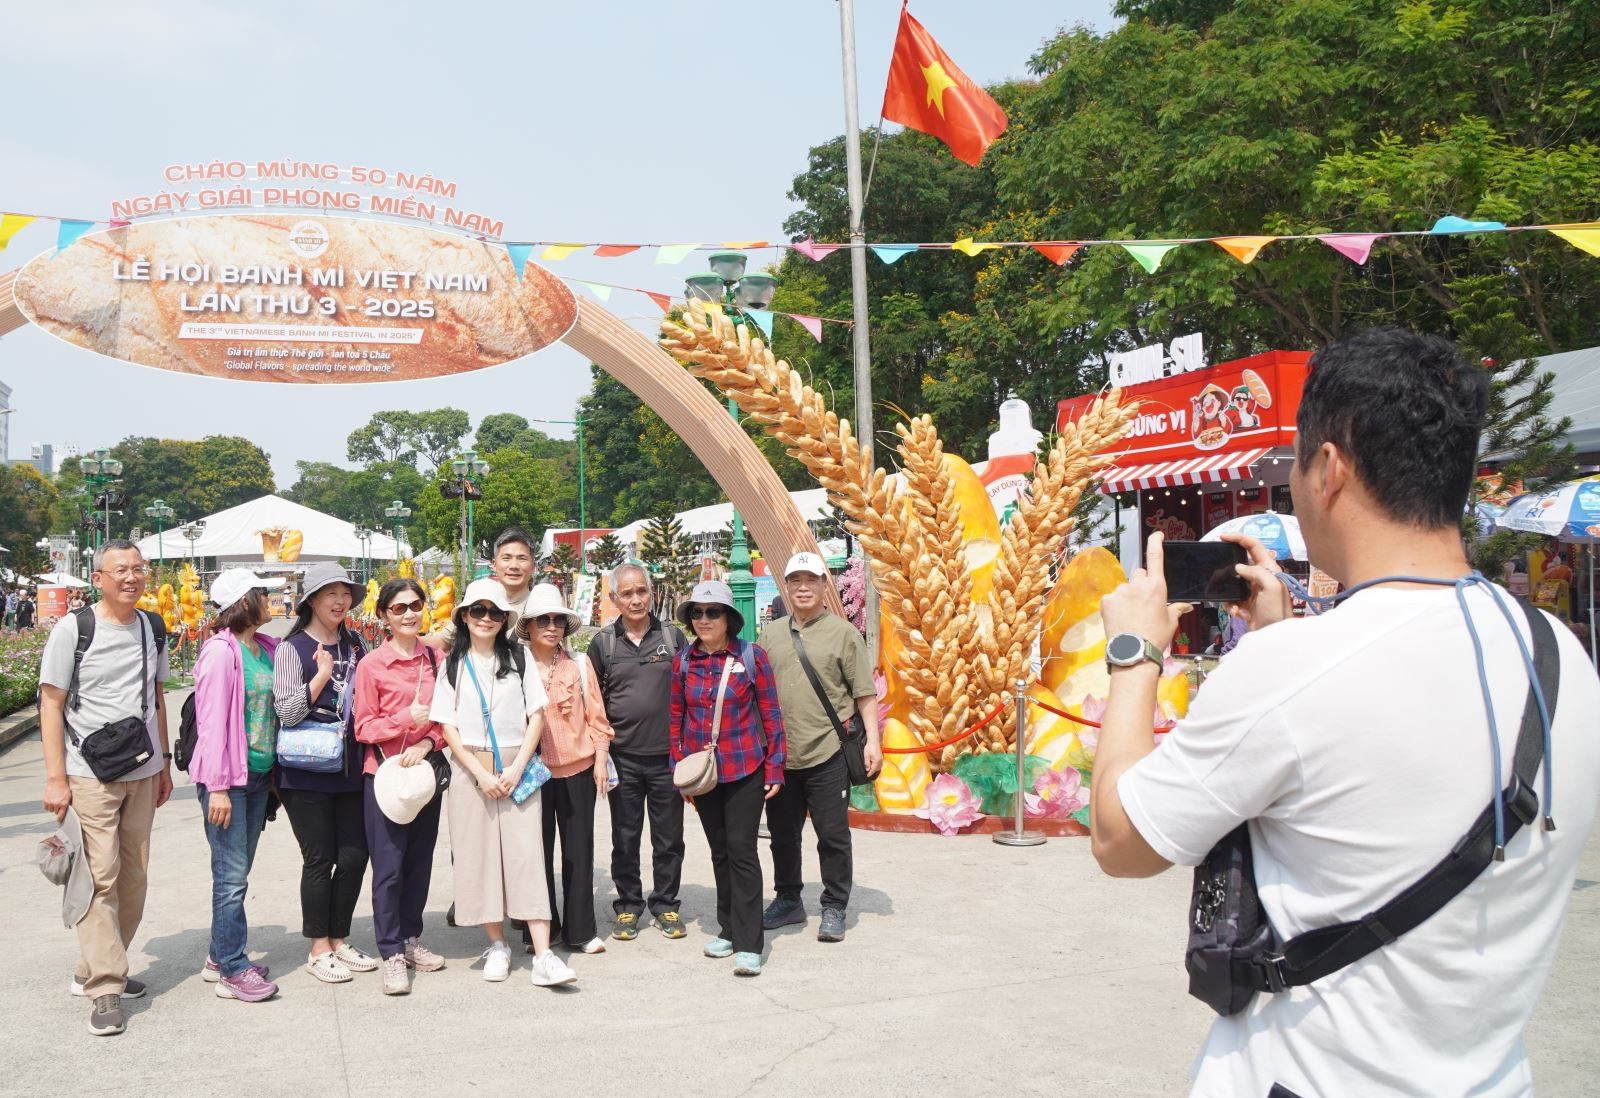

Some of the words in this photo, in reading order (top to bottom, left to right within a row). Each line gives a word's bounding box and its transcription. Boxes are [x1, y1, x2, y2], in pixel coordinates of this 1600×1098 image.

[164, 160, 246, 182] CHÀO
[256, 158, 339, 180] MỪNG
[351, 166, 387, 185] 50
[396, 172, 457, 199] NĂM
[111, 190, 190, 218] NGÀY
[199, 185, 252, 207] GIẢI
[263, 186, 361, 209] PHÓNG
[370, 195, 436, 220] MIỀN
[444, 207, 504, 237] NAM
[313, 265, 345, 287] MÌ
[354, 267, 417, 293] VIỆT
[425, 271, 488, 292] NAM
[319, 297, 336, 315] 3
[365, 299, 435, 318] 2025
[225, 328, 285, 336] VIETNAMESE
[227, 346, 241, 356] Giá
[332, 350, 344, 359] lan
[362, 350, 368, 359] 5
[370, 350, 391, 360] Châu
[255, 361, 285, 371] Flavors
[293, 362, 332, 373] spreading
[334, 362, 347, 371] the
[349, 363, 371, 372] world
[1169, 409, 1186, 435] VỊ
